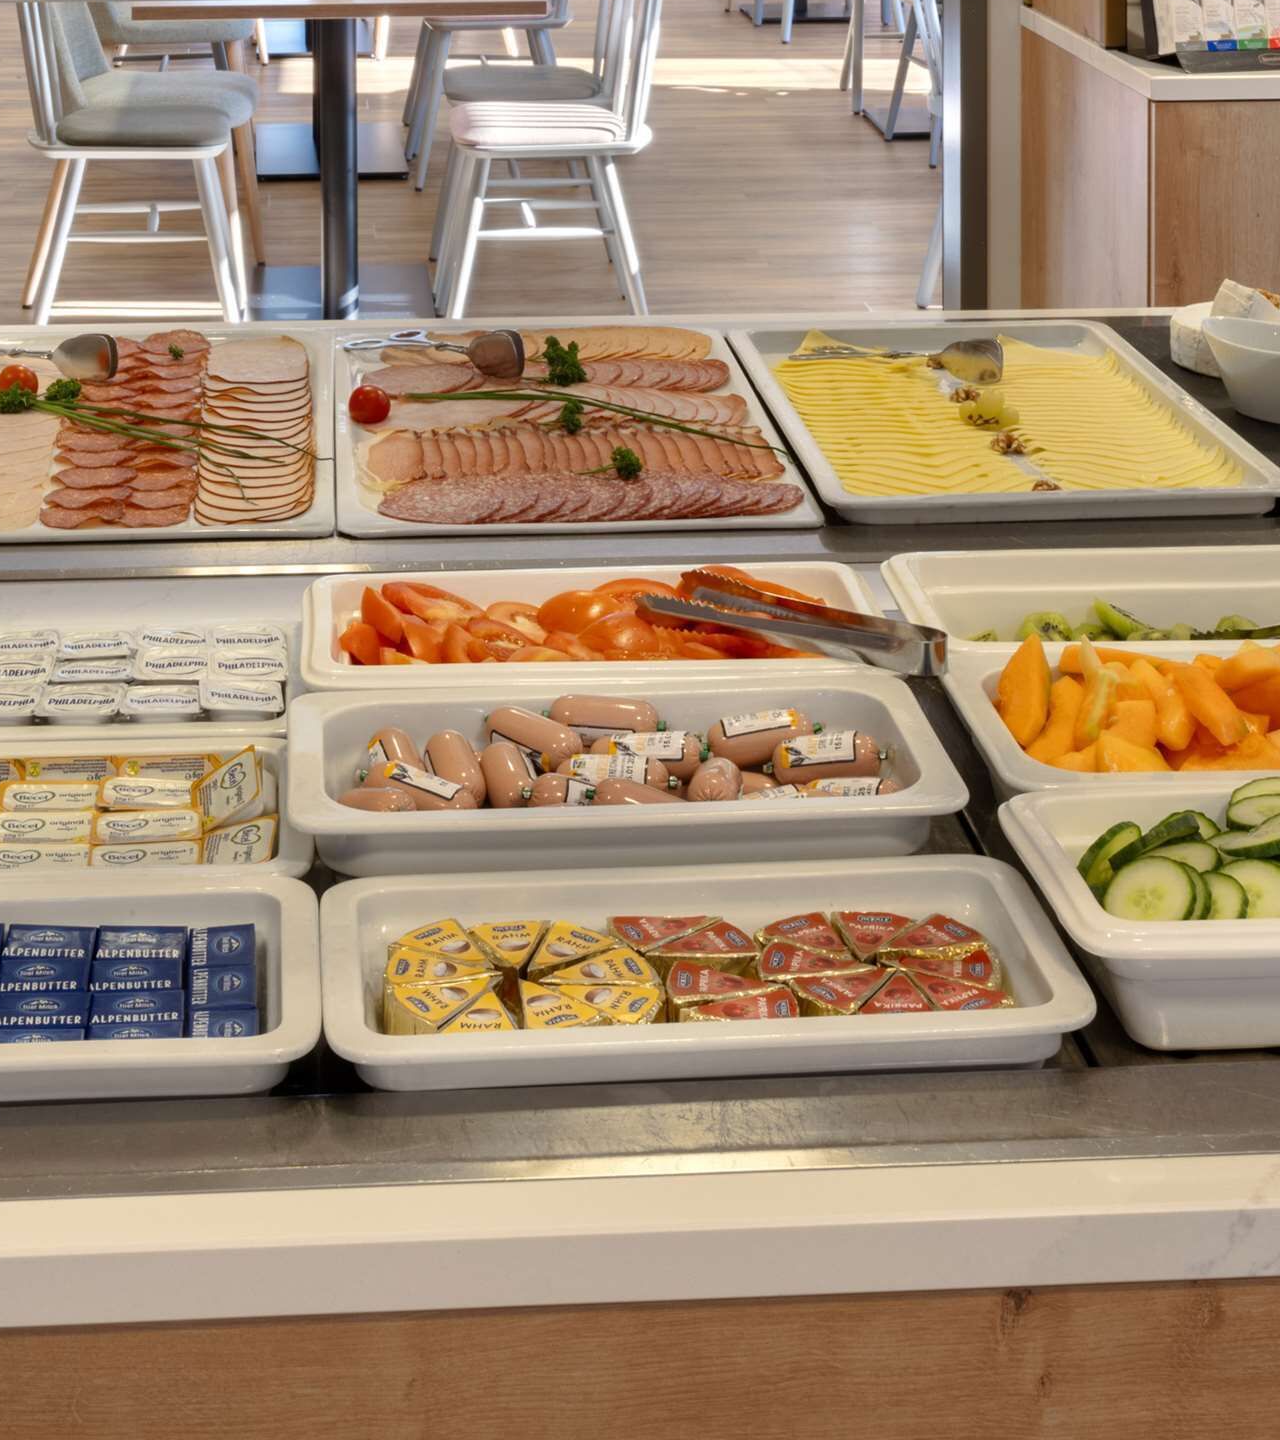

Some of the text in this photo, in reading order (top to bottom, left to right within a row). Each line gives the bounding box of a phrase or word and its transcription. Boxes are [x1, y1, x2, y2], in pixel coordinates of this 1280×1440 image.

[142, 634, 206, 645] PHILADELPHIA
[215, 636, 280, 645] PHILADELPHIA
[64, 641, 129, 650] PHILADELPHIA
[217, 661, 283, 671] PHILADELPHIA
[211, 691, 278, 702] PHILADELPHIA
[48, 698, 115, 706] PHILADELPHIA
[848, 922, 895, 931] PAPRIKA
[492, 932, 530, 940] RAHM
[2, 947, 85, 958] ALPENBUTTER
[96, 948, 180, 959] ALPENBUTTER
[874, 1001, 923, 1009] PAPRIKA
[91, 1011, 178, 1024] ALPENBUTTER
[460, 1022, 502, 1030] RAHM
